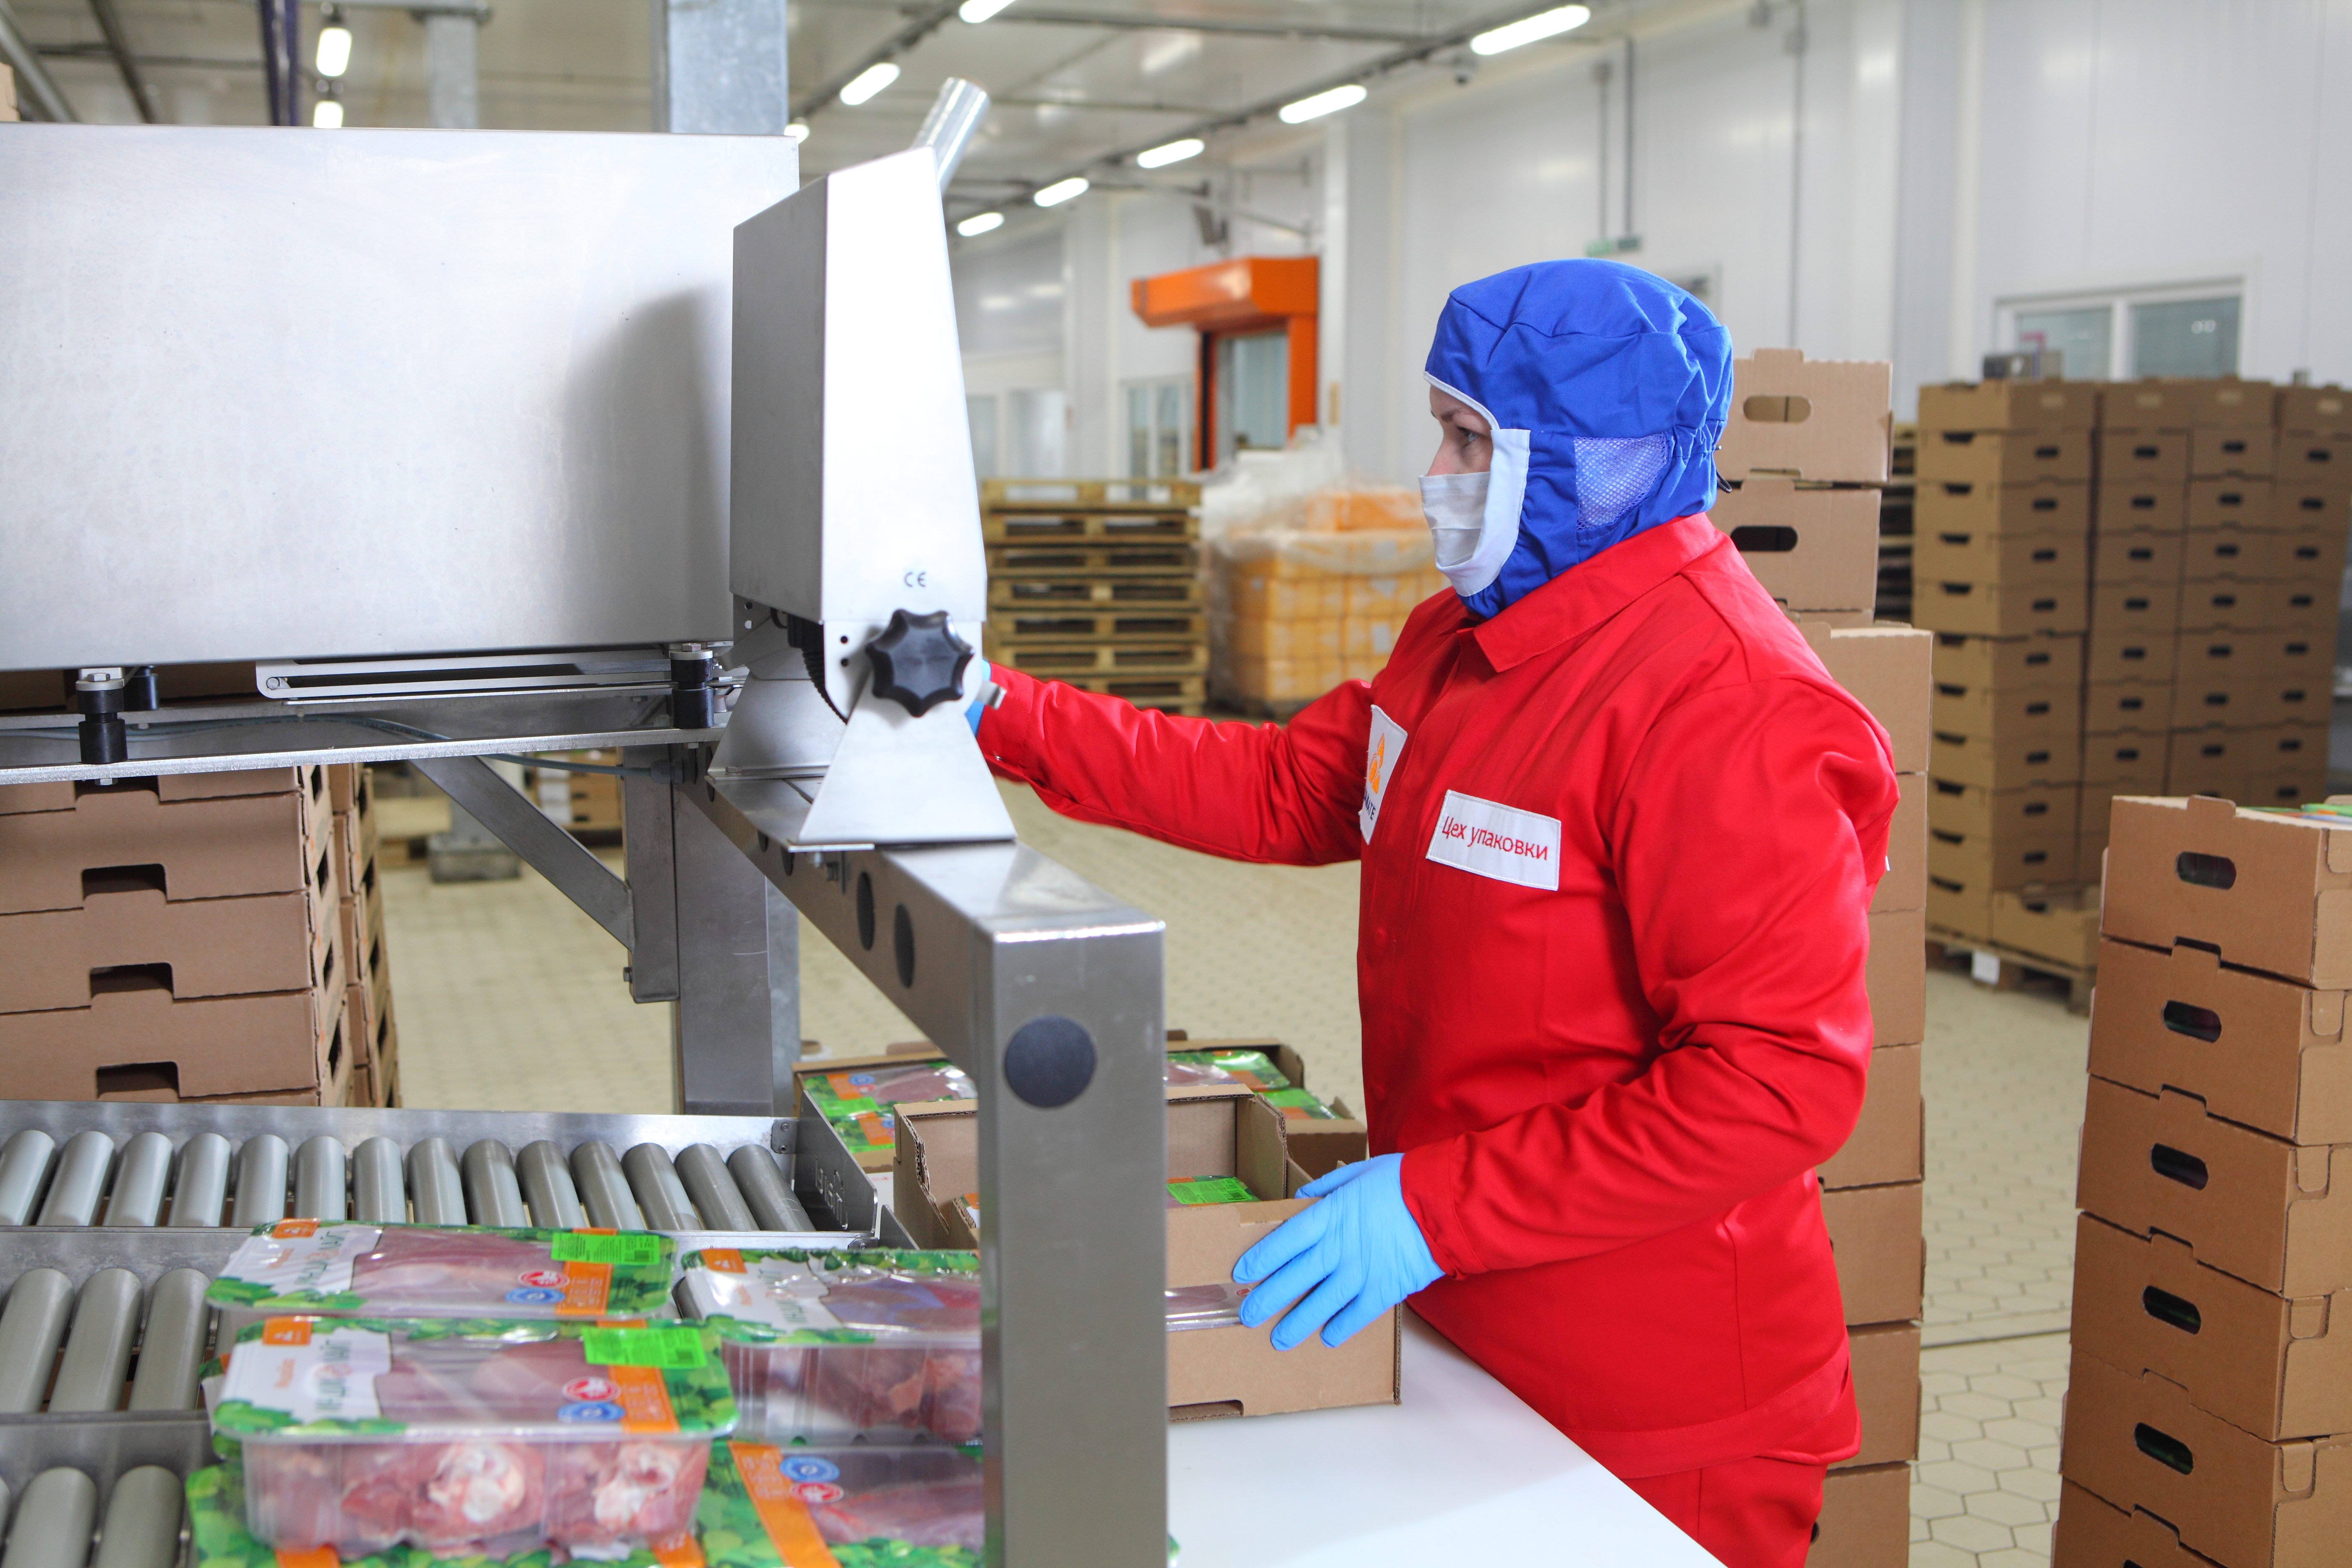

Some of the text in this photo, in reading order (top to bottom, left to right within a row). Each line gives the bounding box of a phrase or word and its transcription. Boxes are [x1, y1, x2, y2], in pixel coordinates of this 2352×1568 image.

[904, 572, 926, 587] CE
[1442, 816, 1548, 861] Цех упаковки
